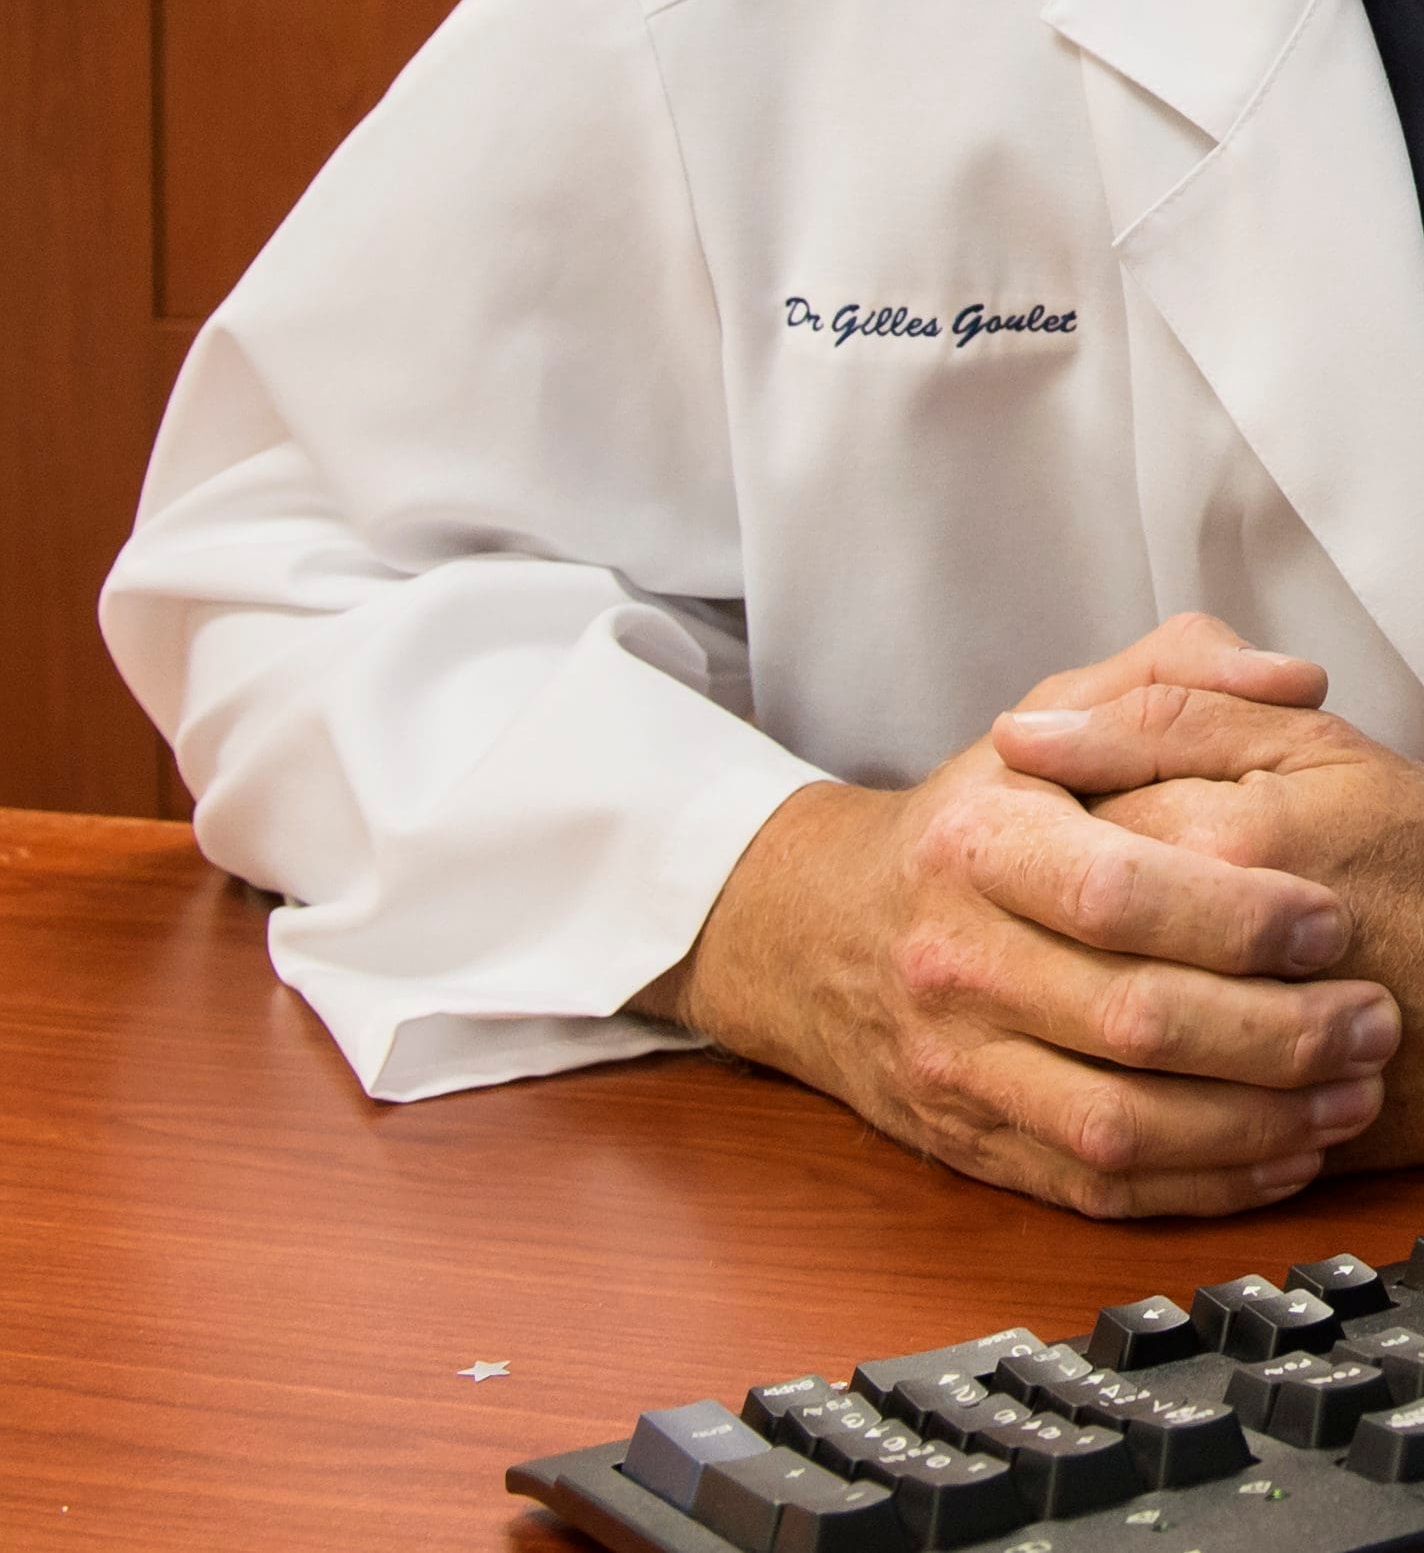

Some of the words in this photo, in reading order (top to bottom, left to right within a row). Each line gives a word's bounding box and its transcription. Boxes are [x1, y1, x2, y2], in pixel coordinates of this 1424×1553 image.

[785, 296, 824, 331] Dr
[831, 303, 943, 347] Gilles
[951, 303, 1078, 348] Goulet
